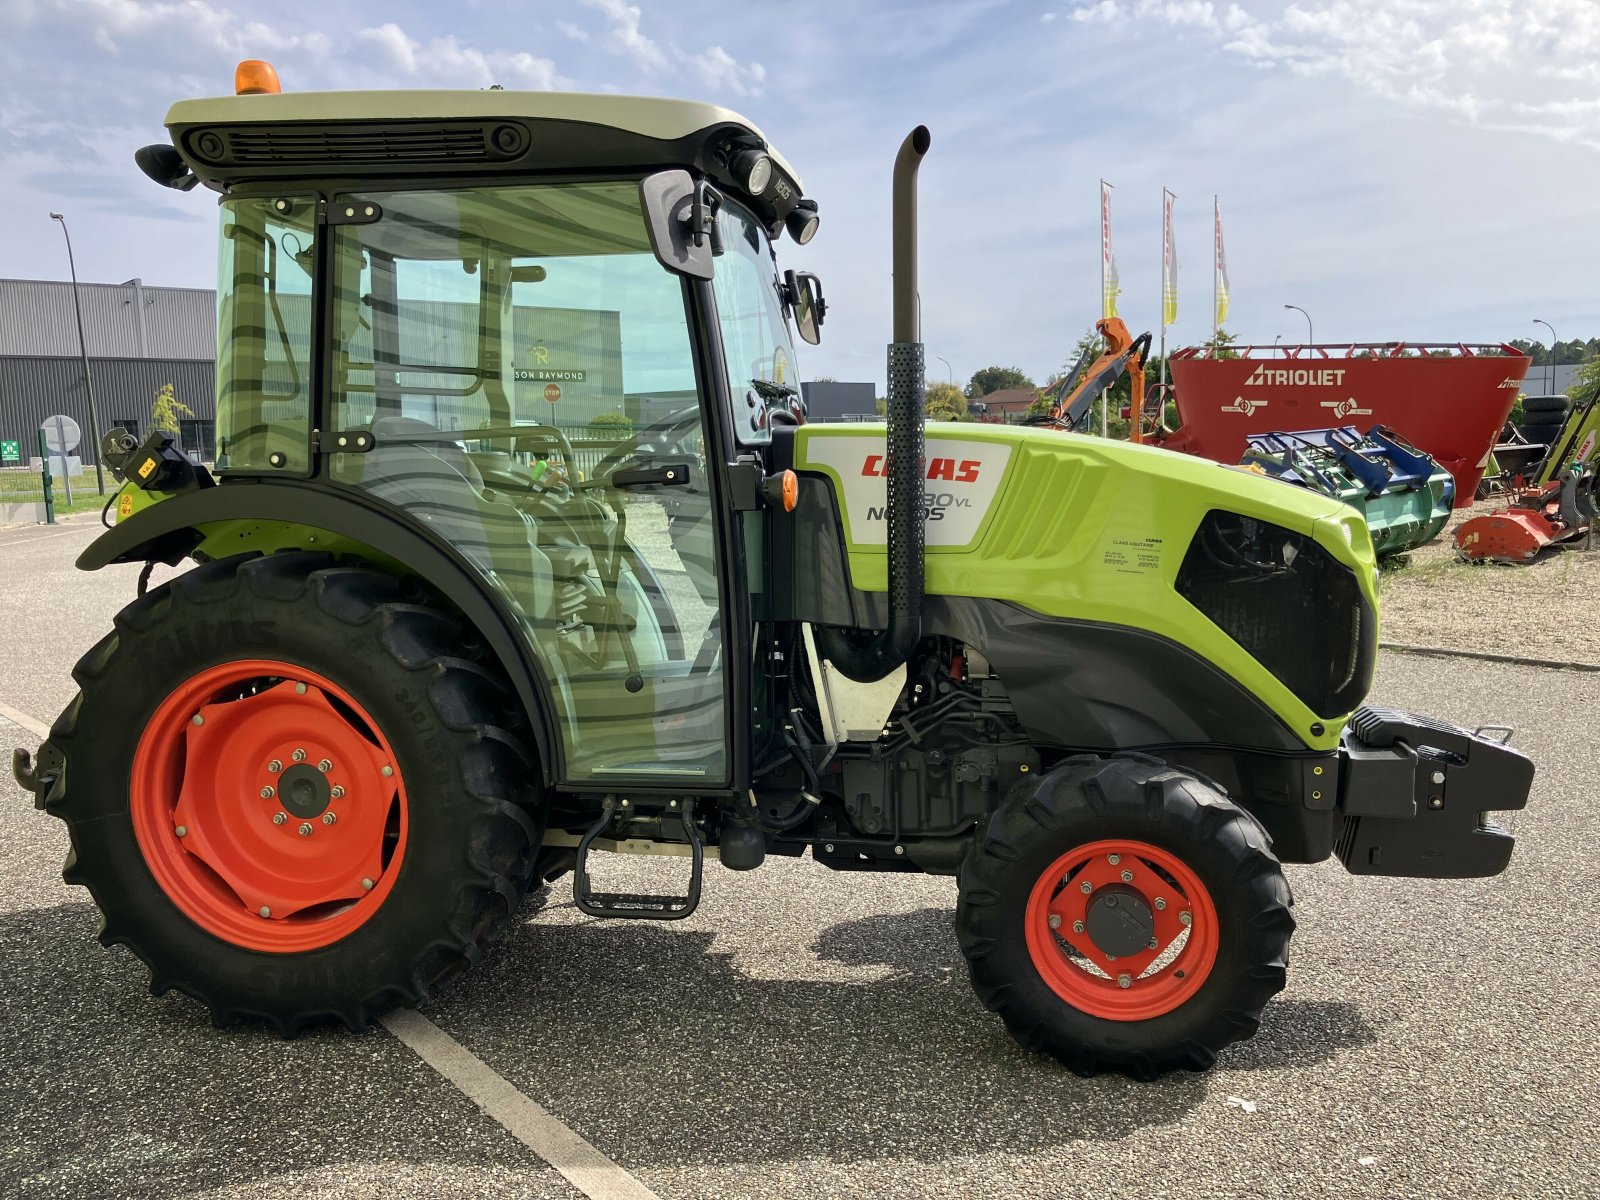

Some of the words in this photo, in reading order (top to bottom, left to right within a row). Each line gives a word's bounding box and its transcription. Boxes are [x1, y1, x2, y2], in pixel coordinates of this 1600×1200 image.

[515, 371, 535, 379] SON
[539, 372, 583, 380] RAYMOND
[1263, 369, 1346, 386] TRIOLIET
[861, 455, 981, 482] CAS
